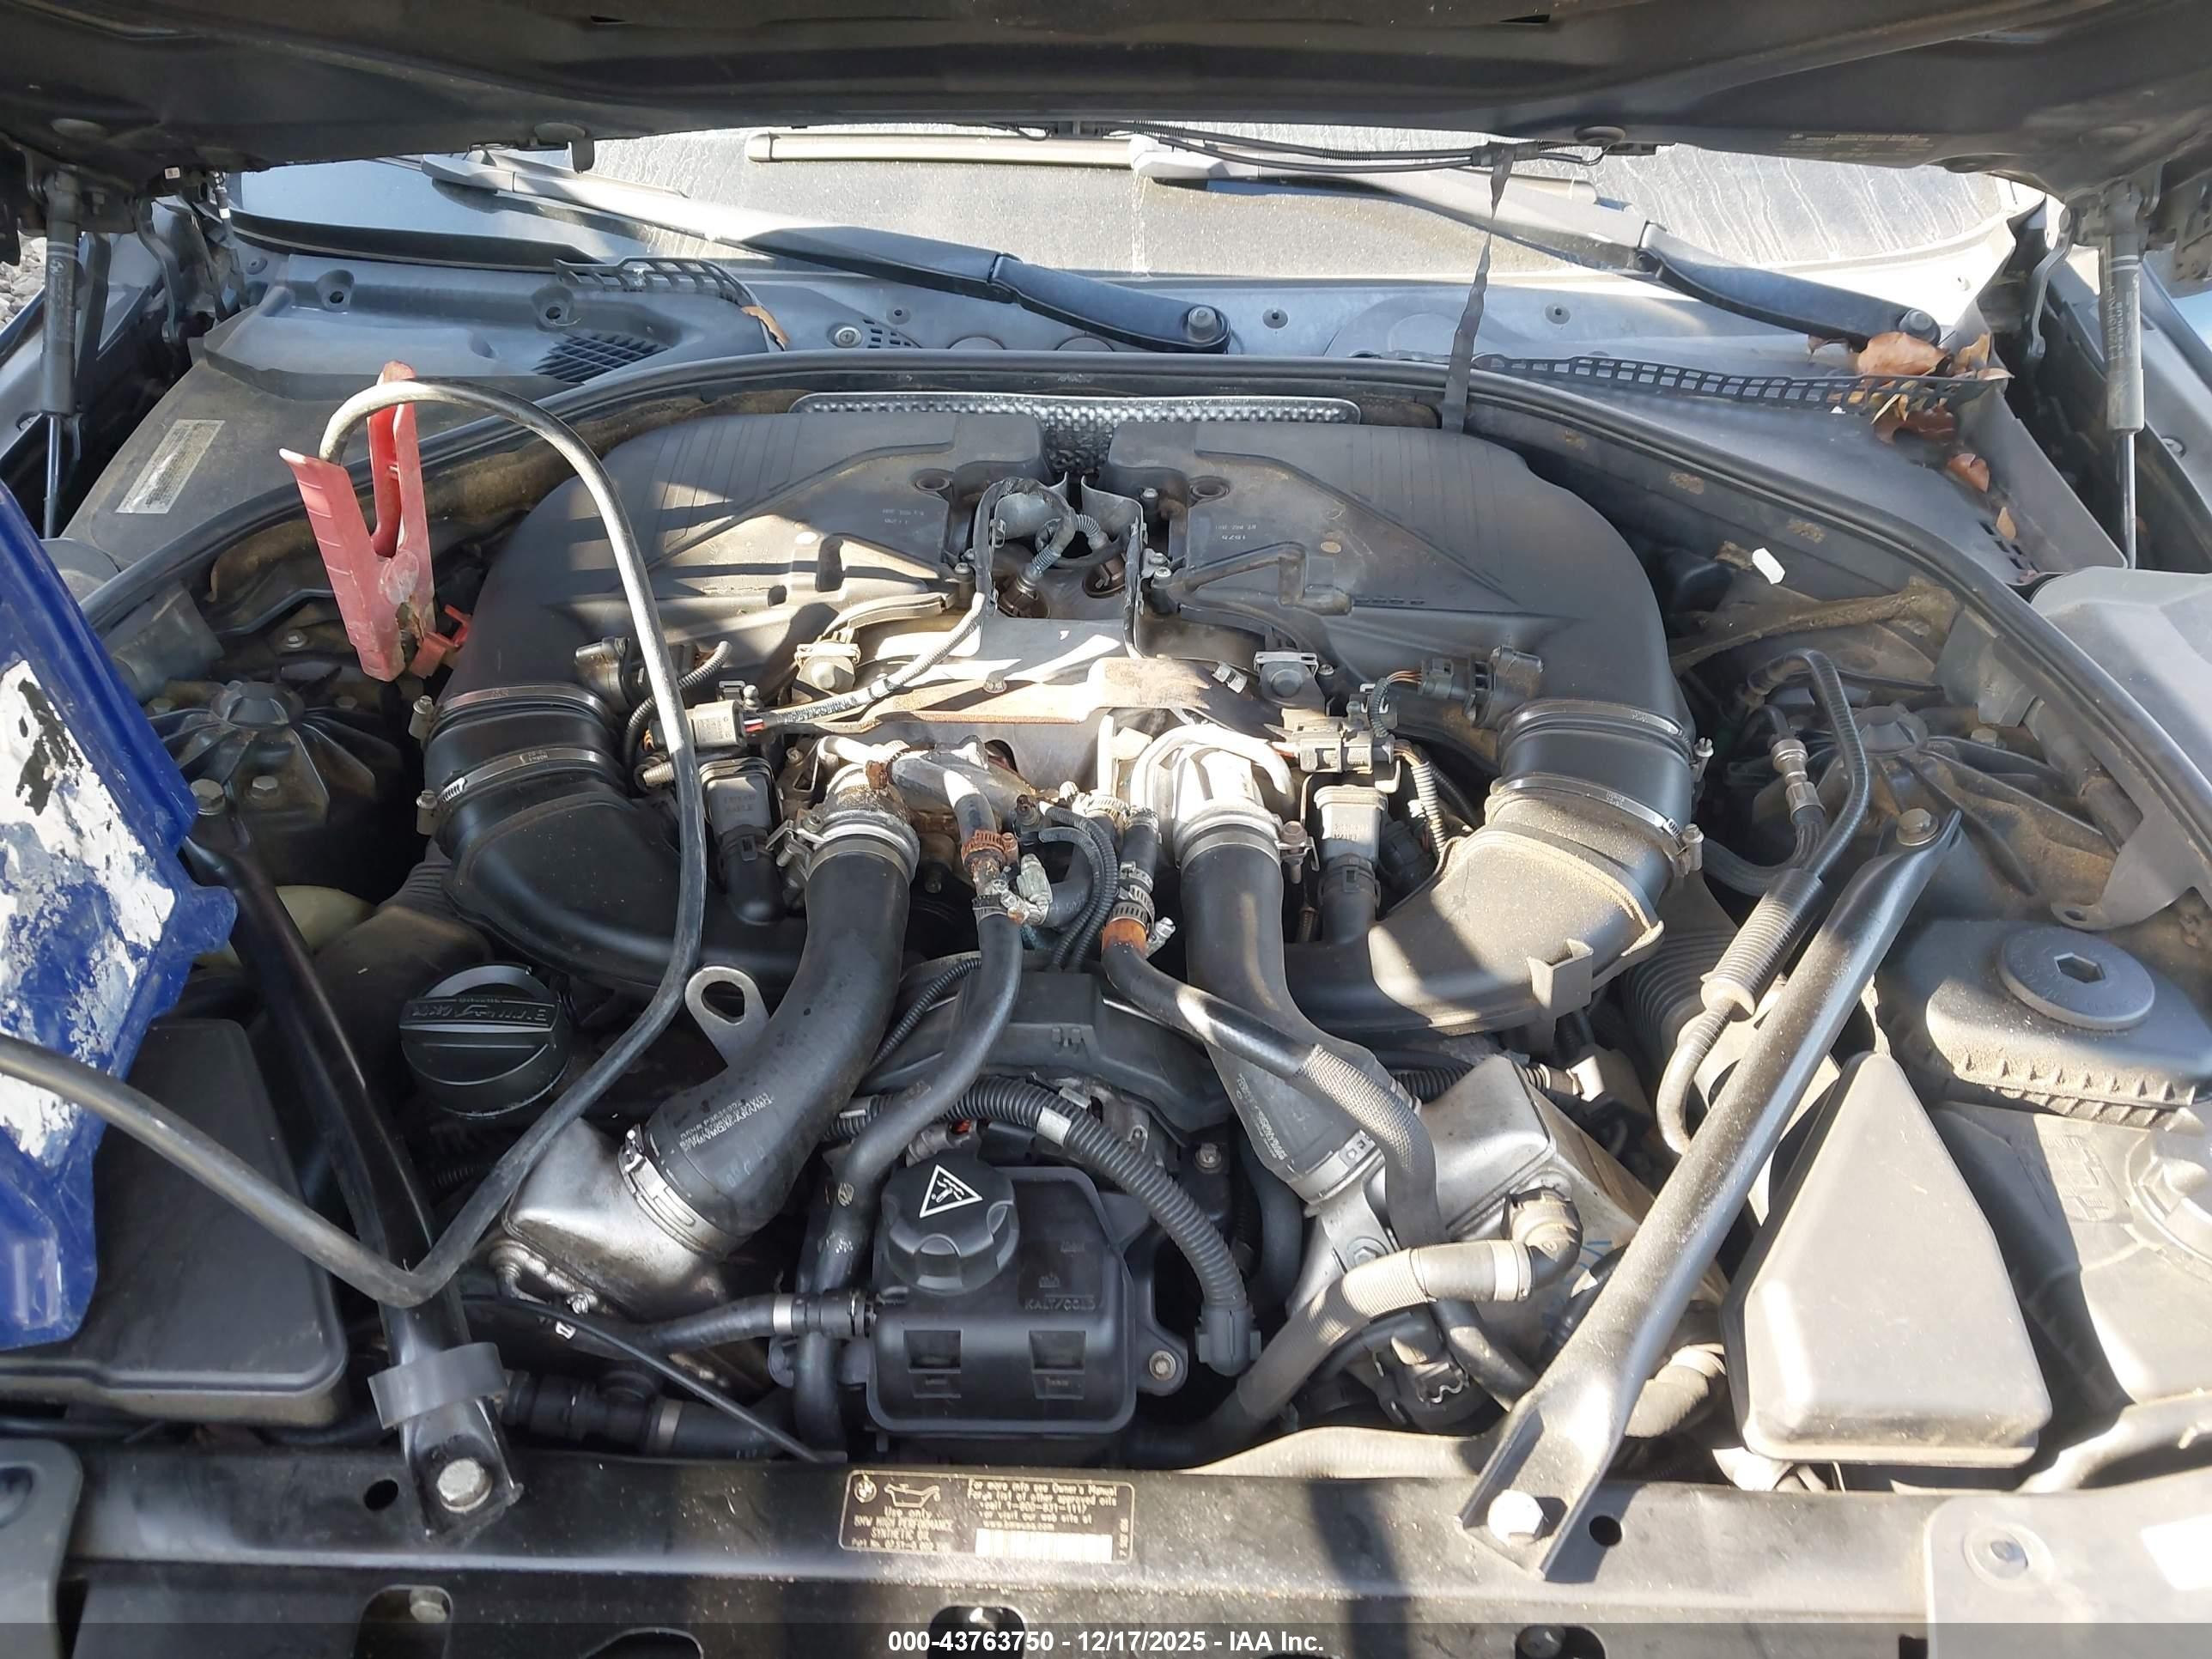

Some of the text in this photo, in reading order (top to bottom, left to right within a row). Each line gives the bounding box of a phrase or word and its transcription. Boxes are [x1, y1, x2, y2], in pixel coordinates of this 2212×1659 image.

[969, 1479, 983, 1491] For
[987, 1481, 1008, 1491] more
[884, 1505, 933, 1520] Use only
[854, 1515, 873, 1527] BMW
